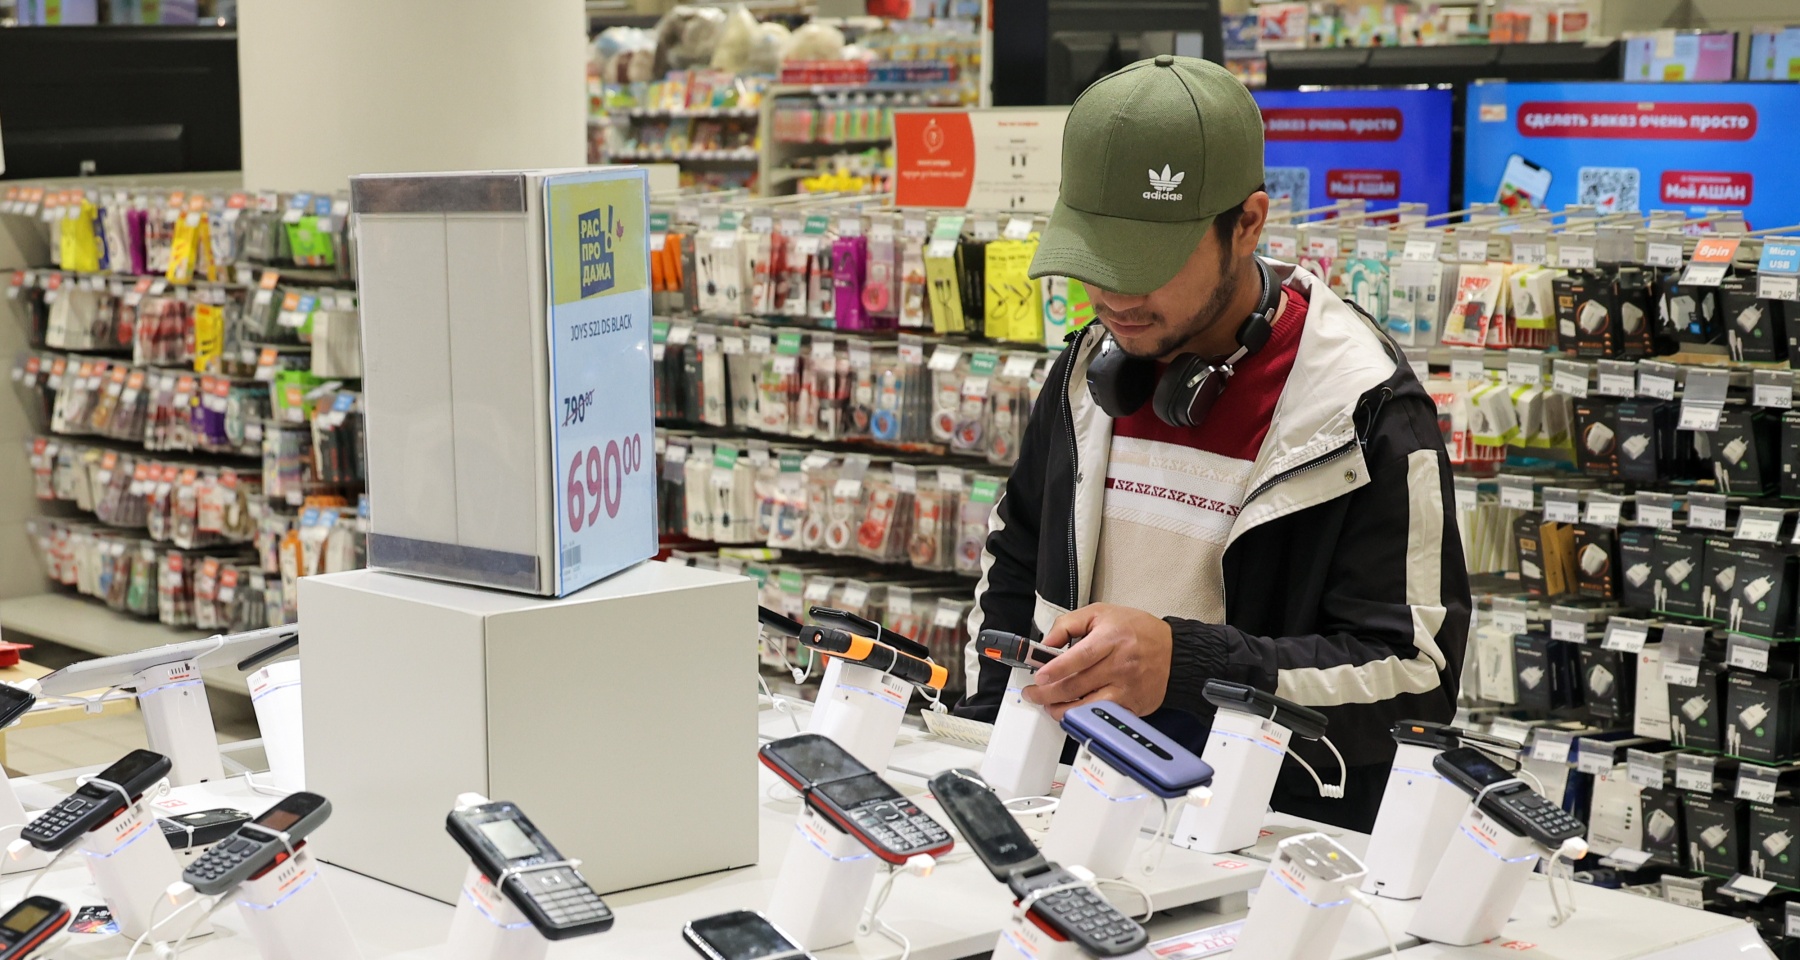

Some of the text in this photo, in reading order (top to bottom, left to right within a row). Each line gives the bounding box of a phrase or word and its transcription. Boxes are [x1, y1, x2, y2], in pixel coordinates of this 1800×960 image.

[1591, 115, 1637, 127] заказ
[1640, 116, 1687, 128] очень
[1690, 115, 1749, 132] просто
[1142, 190, 1183, 201] adidas
[1666, 182, 1746, 201] Мой АШАН
[580, 217, 600, 239] РАС
[581, 240, 600, 262] ПРО
[1699, 244, 1730, 257] 8pin
[1768, 246, 1797, 257] Micro
[582, 261, 612, 287] ДАЖА
[1769, 260, 1791, 270] USB
[570, 322, 588, 341] JOYS
[602, 317, 611, 335] DS
[611, 314, 633, 333] BLACK
